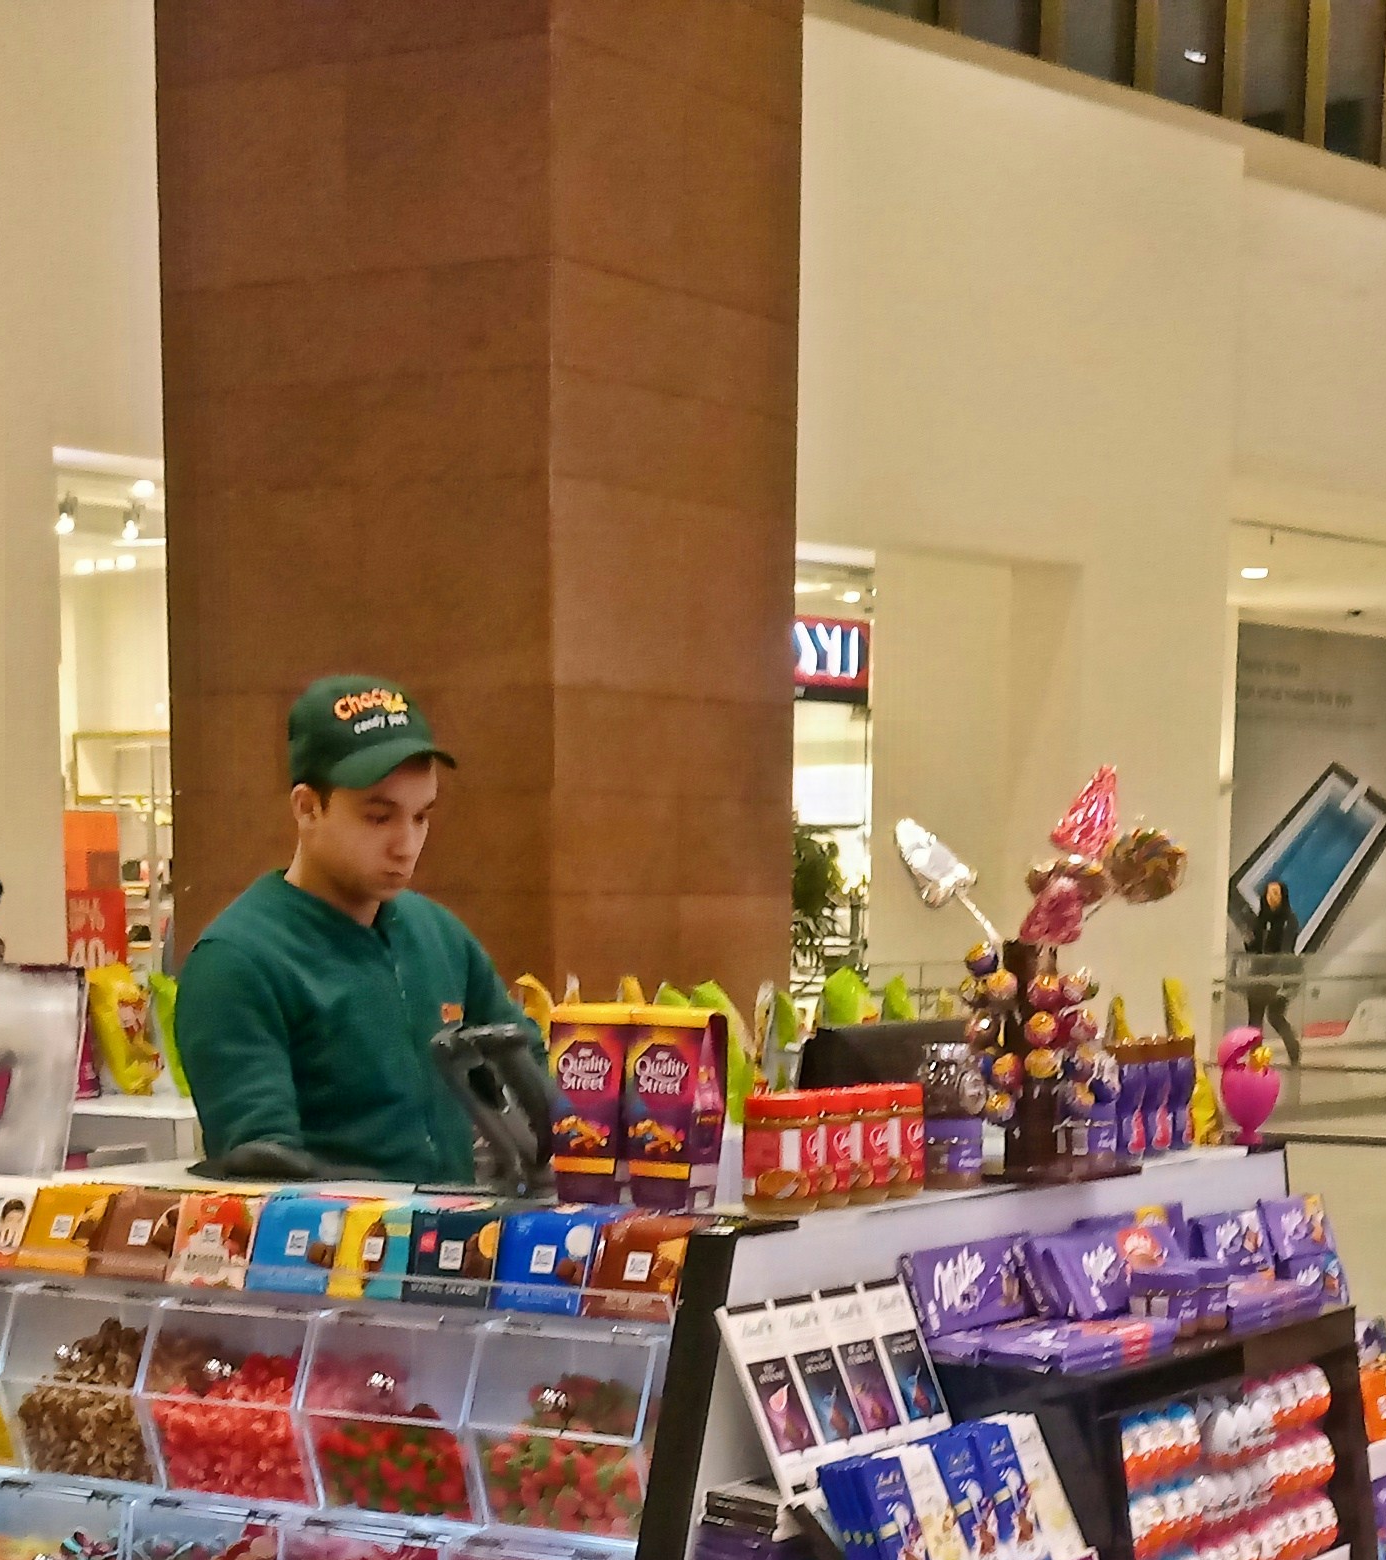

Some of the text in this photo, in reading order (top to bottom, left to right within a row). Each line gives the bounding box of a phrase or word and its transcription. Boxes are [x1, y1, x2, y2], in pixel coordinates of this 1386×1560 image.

[558, 1052, 612, 1079] Quality
[635, 1055, 689, 1083] Quality
[562, 1072, 605, 1091] Street
[639, 1075, 682, 1096] Street
